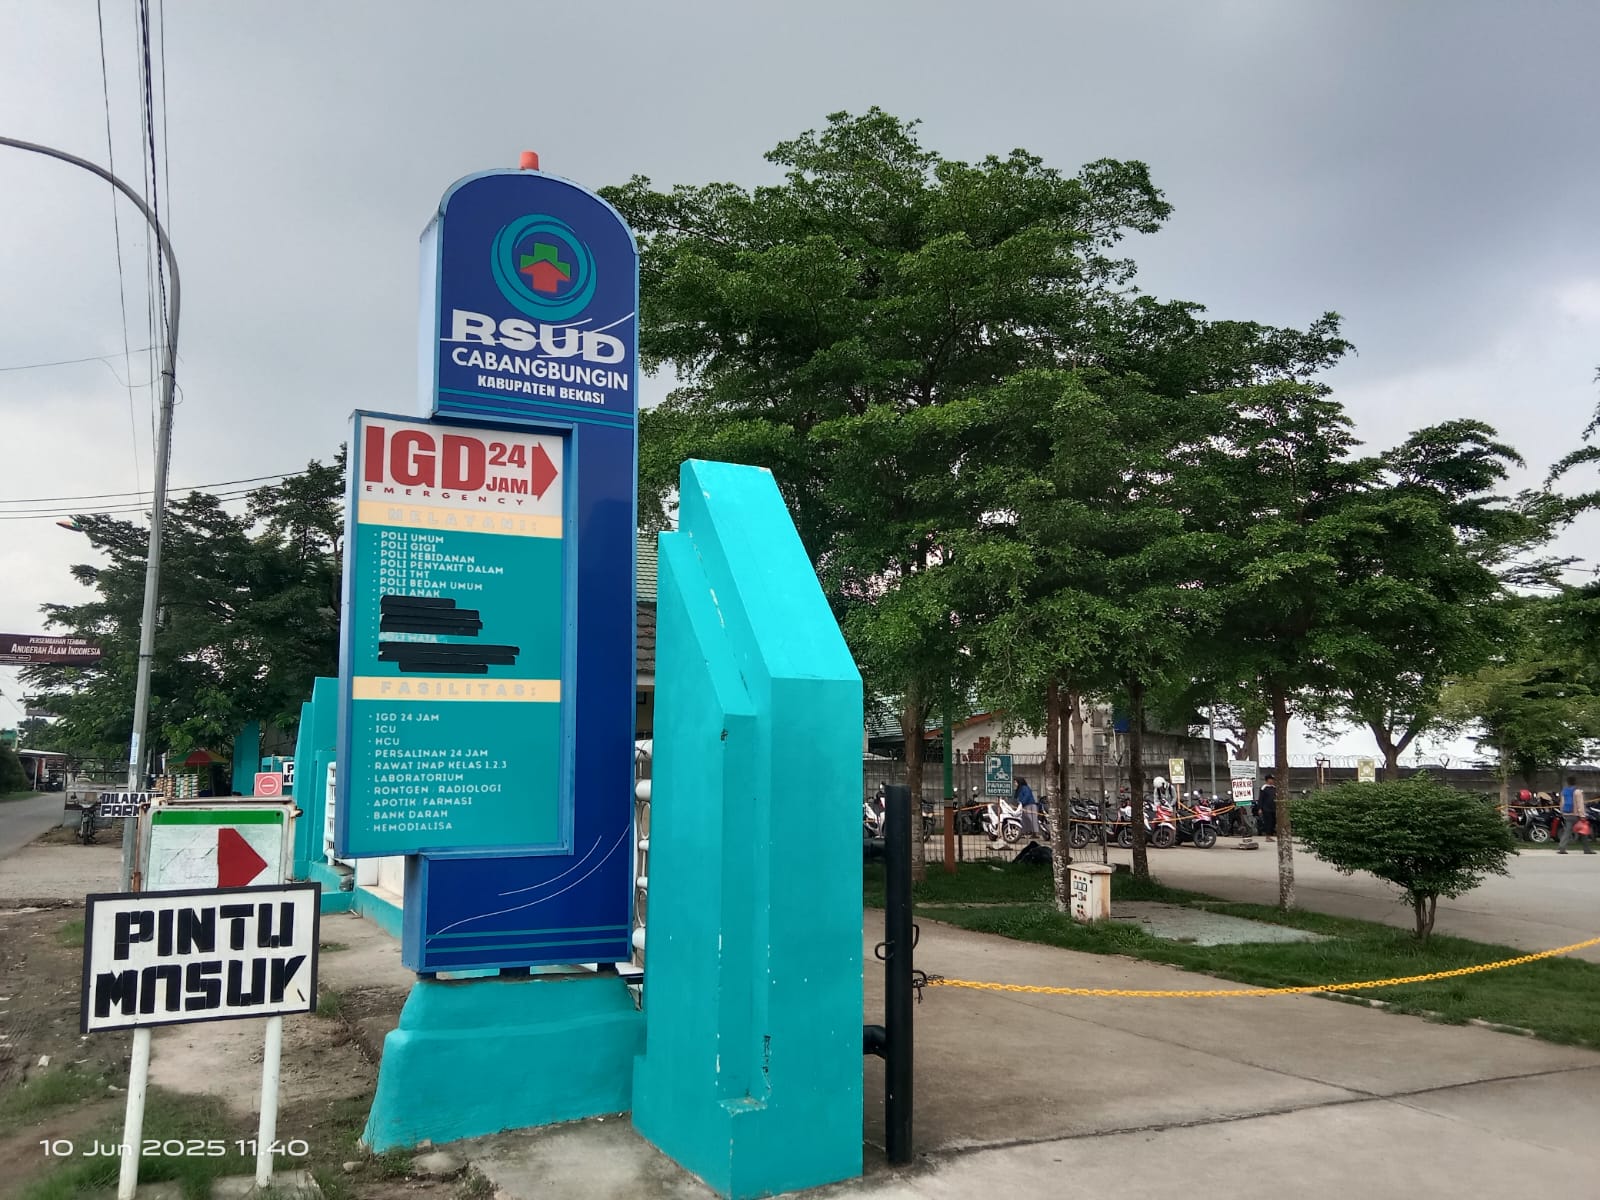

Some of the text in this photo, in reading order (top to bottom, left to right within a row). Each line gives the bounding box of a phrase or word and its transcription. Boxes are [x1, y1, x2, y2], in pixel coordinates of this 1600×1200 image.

[452, 309, 625, 364] RSUD
[452, 347, 628, 391] CABANGBUNGIN
[478, 375, 604, 405] KABUPATEN BEKASI
[365, 425, 486, 491] IGD
[488, 442, 526, 468] 24
[486, 476, 528, 494] JAM
[366, 486, 523, 506] EMERGENCY
[381, 531, 444, 544] POLI UMUM
[381, 541, 436, 552] POLI GIGI
[381, 550, 475, 564] POLI KEBIDANAN
[381, 559, 504, 575] POLI PENYAKIT DALAM
[381, 568, 430, 579] POLI THT
[381, 577, 483, 591] POLI BEDAH UMUM
[380, 586, 440, 598] POLI ANAK
[11, 643, 100, 656] ANUGERAH ALAM INDONESIA
[380, 681, 536, 696] FASILITAS:
[376, 713, 440, 722] IGD 24 JAM
[375, 725, 396, 734] ICU
[375, 737, 400, 746] HCU
[374, 748, 488, 758] PERSALINAN 24 JAM
[374, 762, 413, 770] RAWAT
[417, 762, 445, 770] INAP
[448, 760, 482, 769] KELAS
[988, 757, 1001, 774] P
[374, 773, 464, 782] LABORATORIUM
[374, 784, 502, 795] RONTGEN RADIOLOGI
[374, 796, 472, 808] APOTIK FARMASI
[374, 810, 448, 820] BANK DARAH
[374, 822, 452, 832] HEMODIALISA
[114, 902, 294, 960] PINTU
[94, 955, 307, 1018] MASUK
